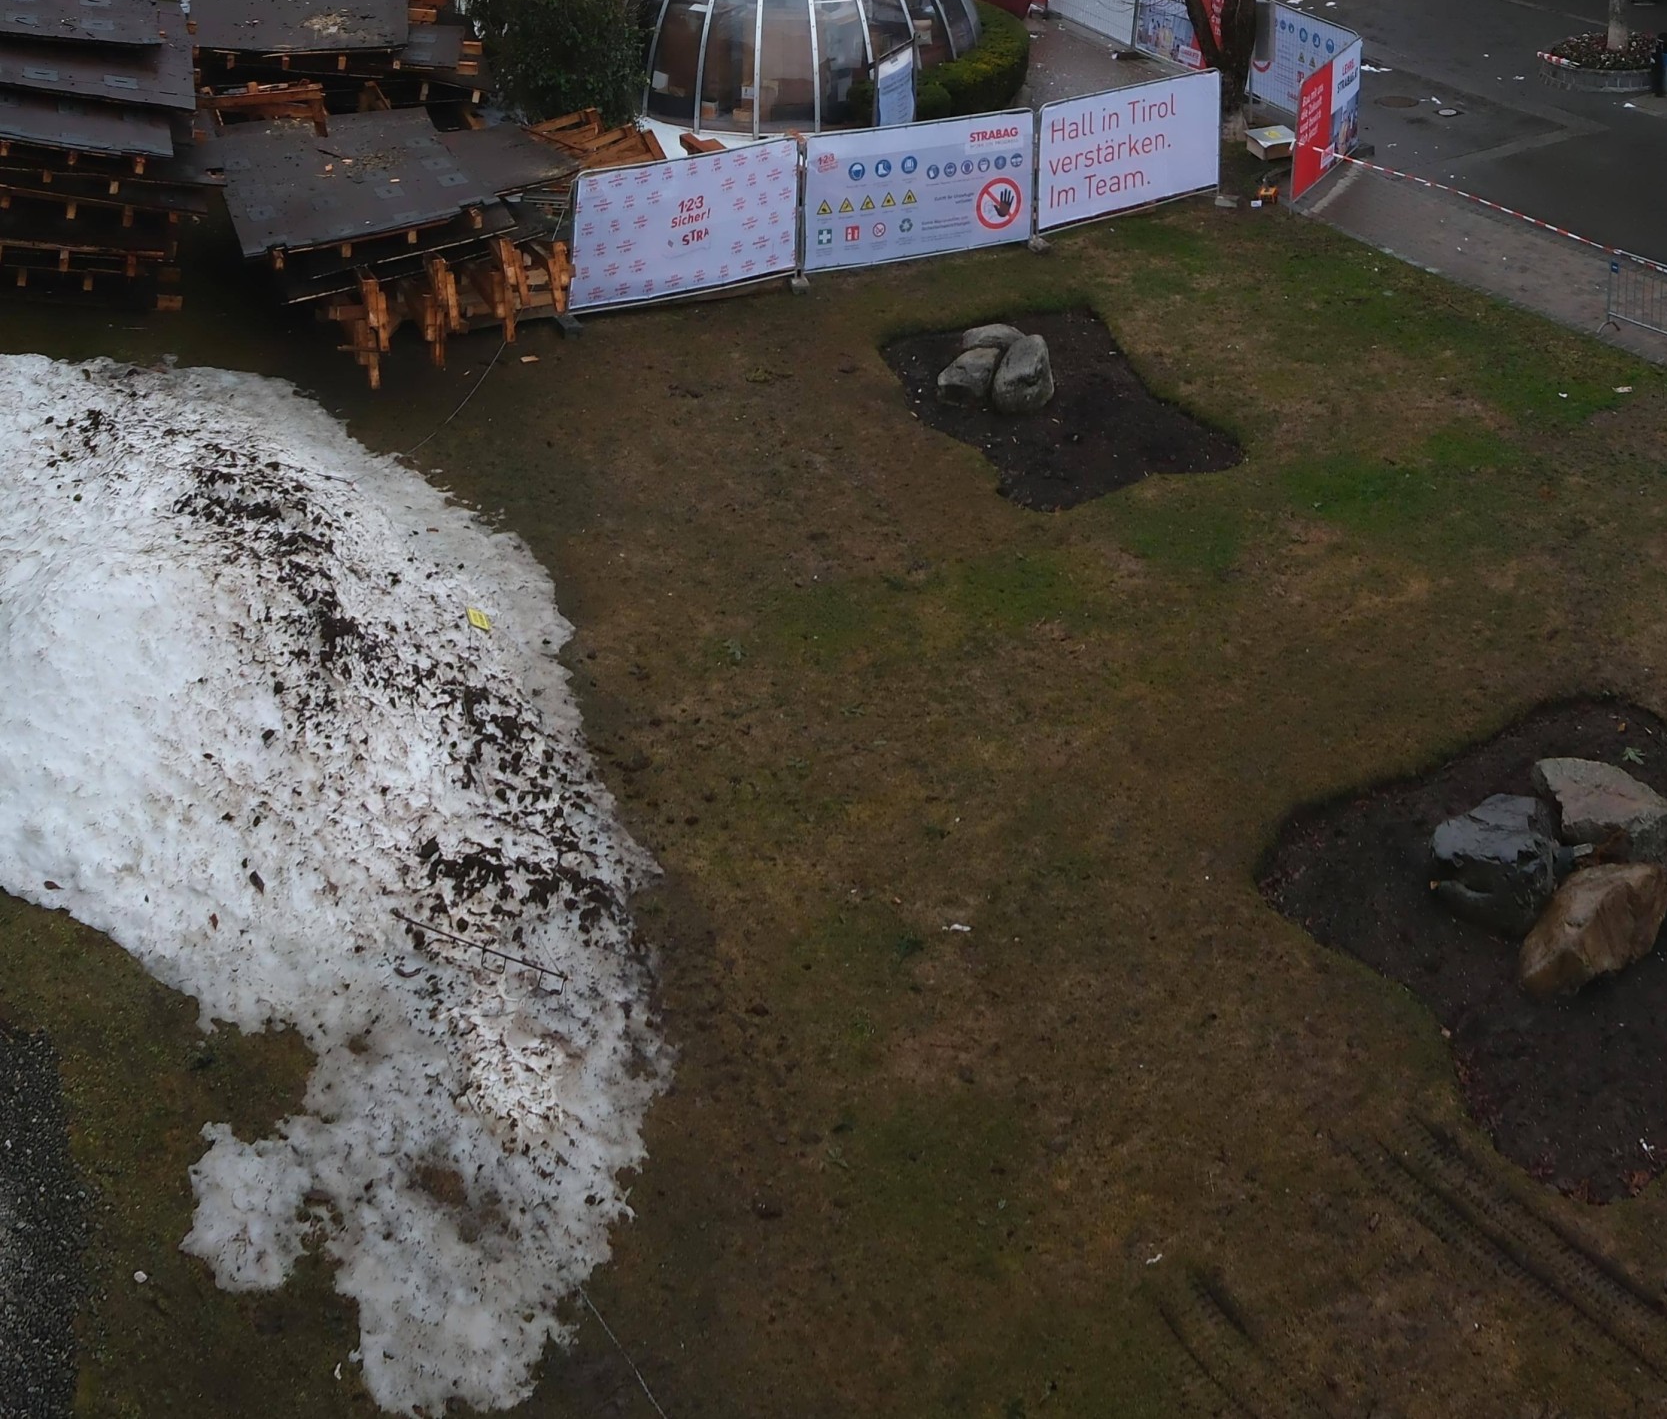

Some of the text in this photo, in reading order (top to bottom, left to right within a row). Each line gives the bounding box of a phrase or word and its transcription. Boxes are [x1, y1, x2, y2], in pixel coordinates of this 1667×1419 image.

[969, 126, 1018, 143] STRABAG
[1050, 92, 1176, 144] Hall in Tirol
[1049, 133, 1172, 176] verstärken.
[1050, 170, 1151, 209] Im Team.
[670, 207, 712, 229] Sicher!
